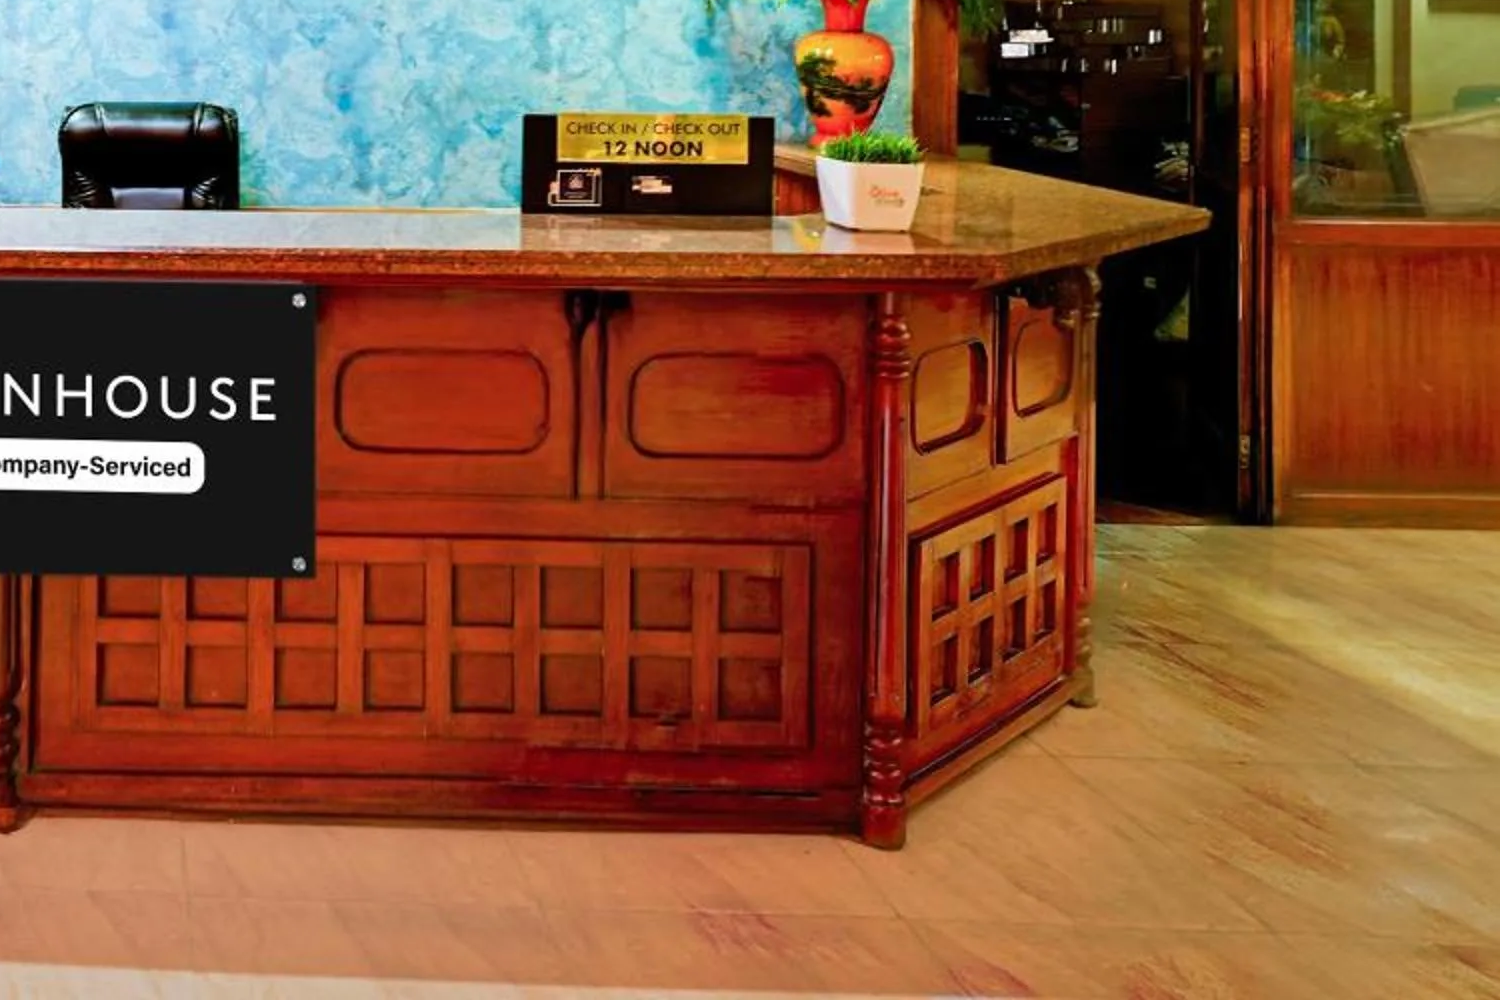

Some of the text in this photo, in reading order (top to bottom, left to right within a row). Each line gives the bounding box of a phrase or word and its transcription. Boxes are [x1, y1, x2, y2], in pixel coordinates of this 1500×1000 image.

[566, 122, 616, 135] CHECK
[621, 123, 637, 134] IN
[653, 122, 704, 136] CHECK
[707, 123, 741, 136] OUT
[603, 140, 704, 157] 12 NOON
